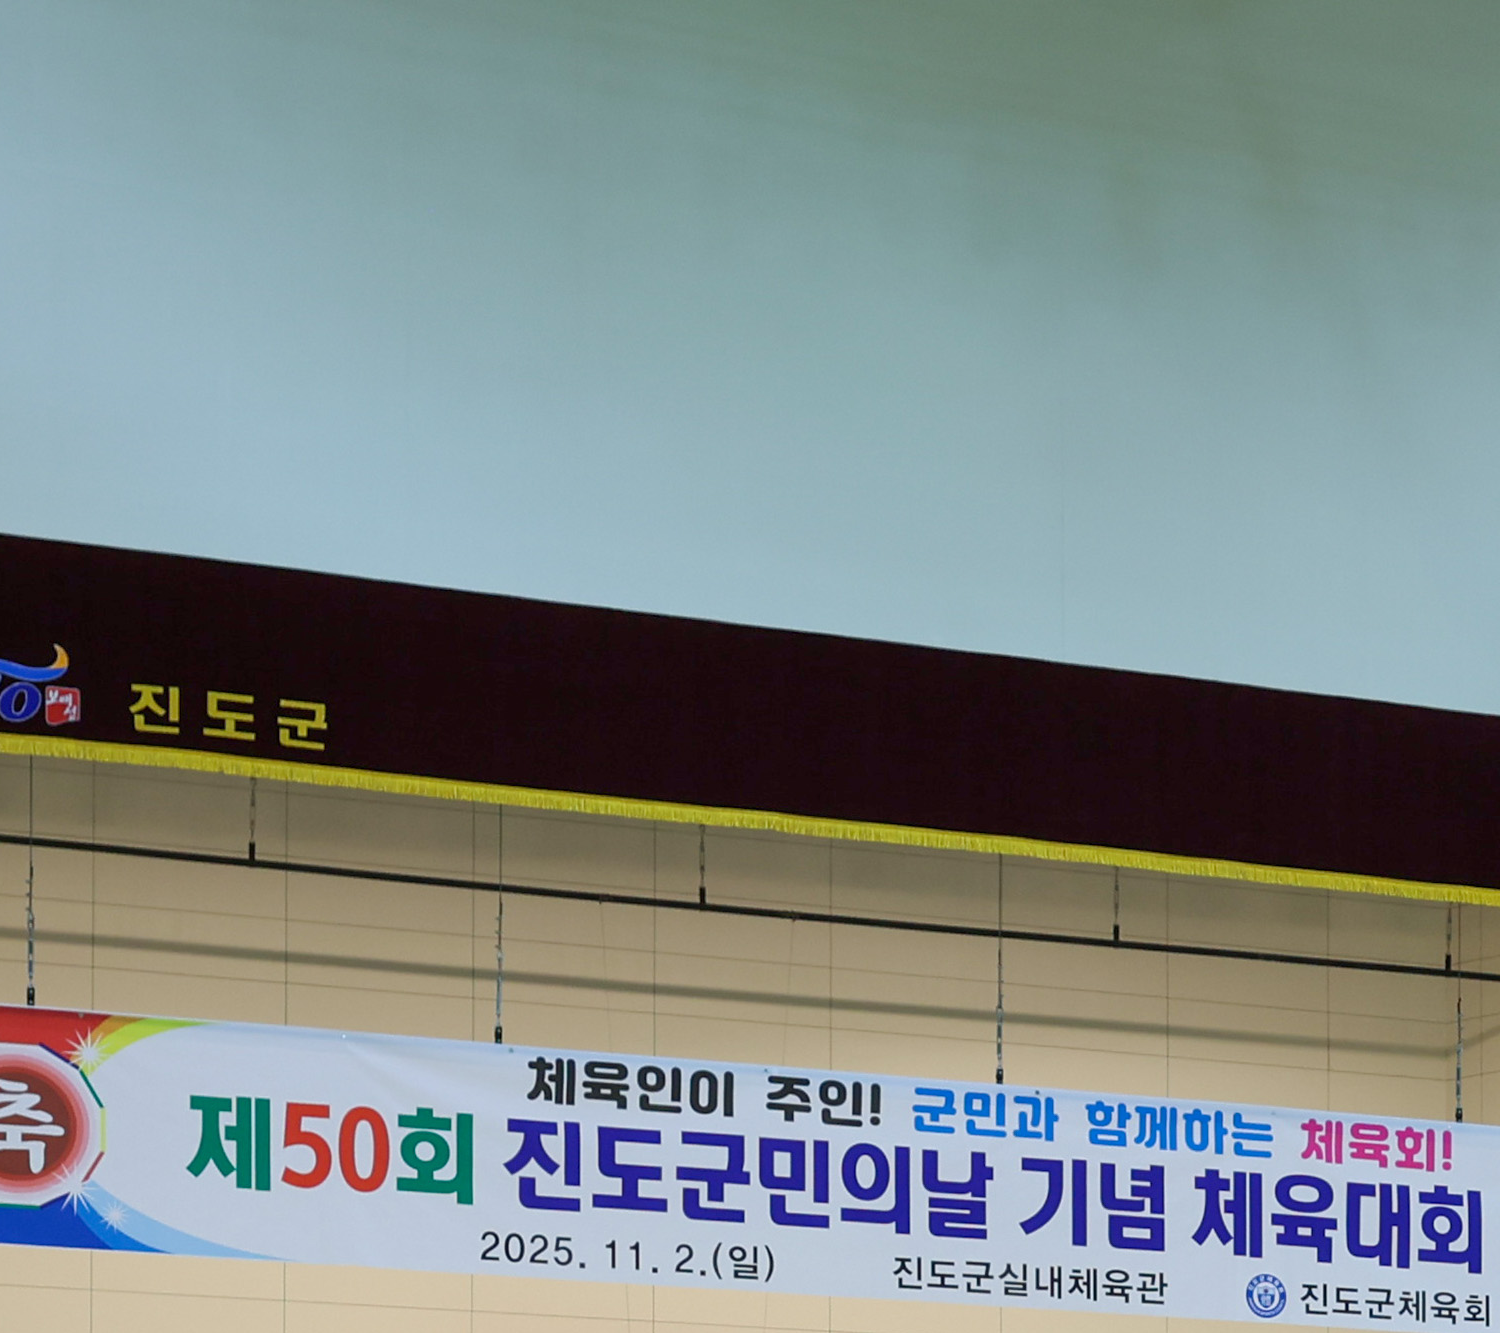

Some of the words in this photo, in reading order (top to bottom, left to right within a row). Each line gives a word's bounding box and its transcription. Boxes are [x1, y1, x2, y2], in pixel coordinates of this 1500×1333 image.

[128, 682, 328, 751] 진도군
[525, 1056, 736, 1119] 체육인이
[767, 1074, 883, 1129] 주인!
[911, 1087, 1060, 1142] 군민과
[1085, 1098, 1275, 1160] 함께하는
[1300, 1118, 1454, 1172] 체육회!
[186, 1093, 475, 1206] 제50회
[503, 1116, 993, 1242] 진도군민의날
[1017, 1155, 1167, 1252] 기념
[1190, 1170, 1484, 1275] 체육대회
[480, 1231, 589, 1271] 2025.
[892, 1254, 1169, 1307] 진도군실내체육관
[1299, 1281, 1492, 1328] 진도군체육회
